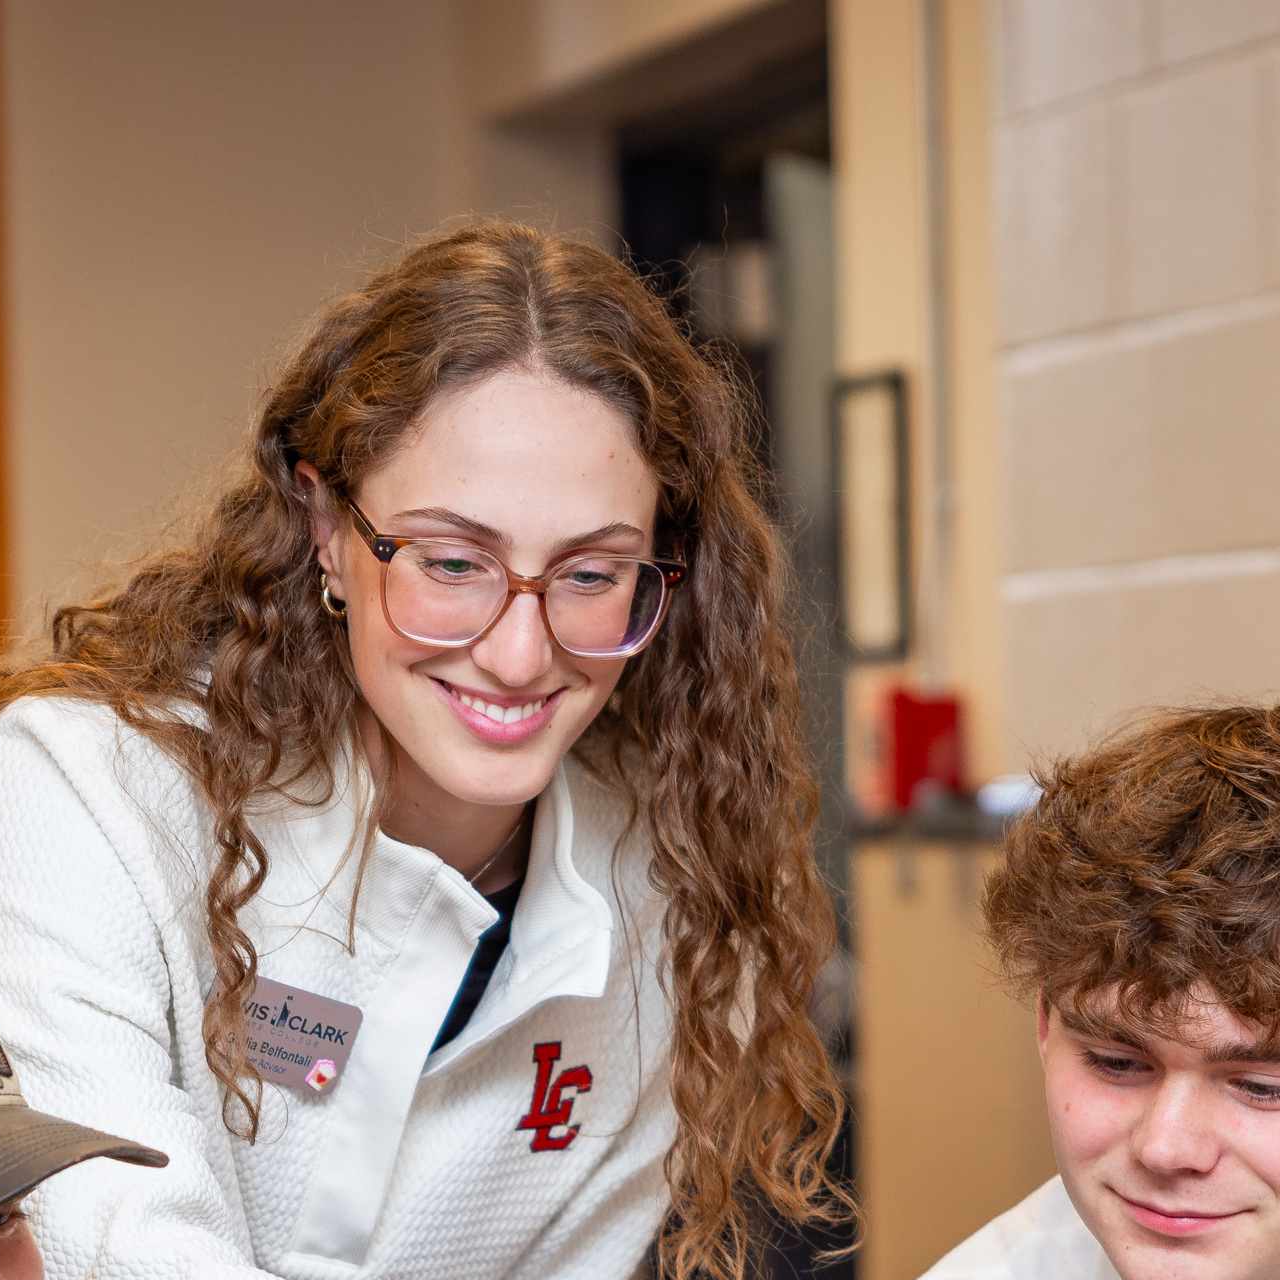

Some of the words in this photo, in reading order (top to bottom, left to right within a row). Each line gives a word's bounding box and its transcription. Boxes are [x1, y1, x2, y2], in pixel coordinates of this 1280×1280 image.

[245, 1020, 264, 1031] ATE
[270, 1028, 320, 1048] COLLEGE
[288, 1015, 349, 1045] CLARK
[257, 1058, 288, 1075] Advisor
[259, 1041, 313, 1067] Belfontali
[515, 1041, 593, 1152] LC
